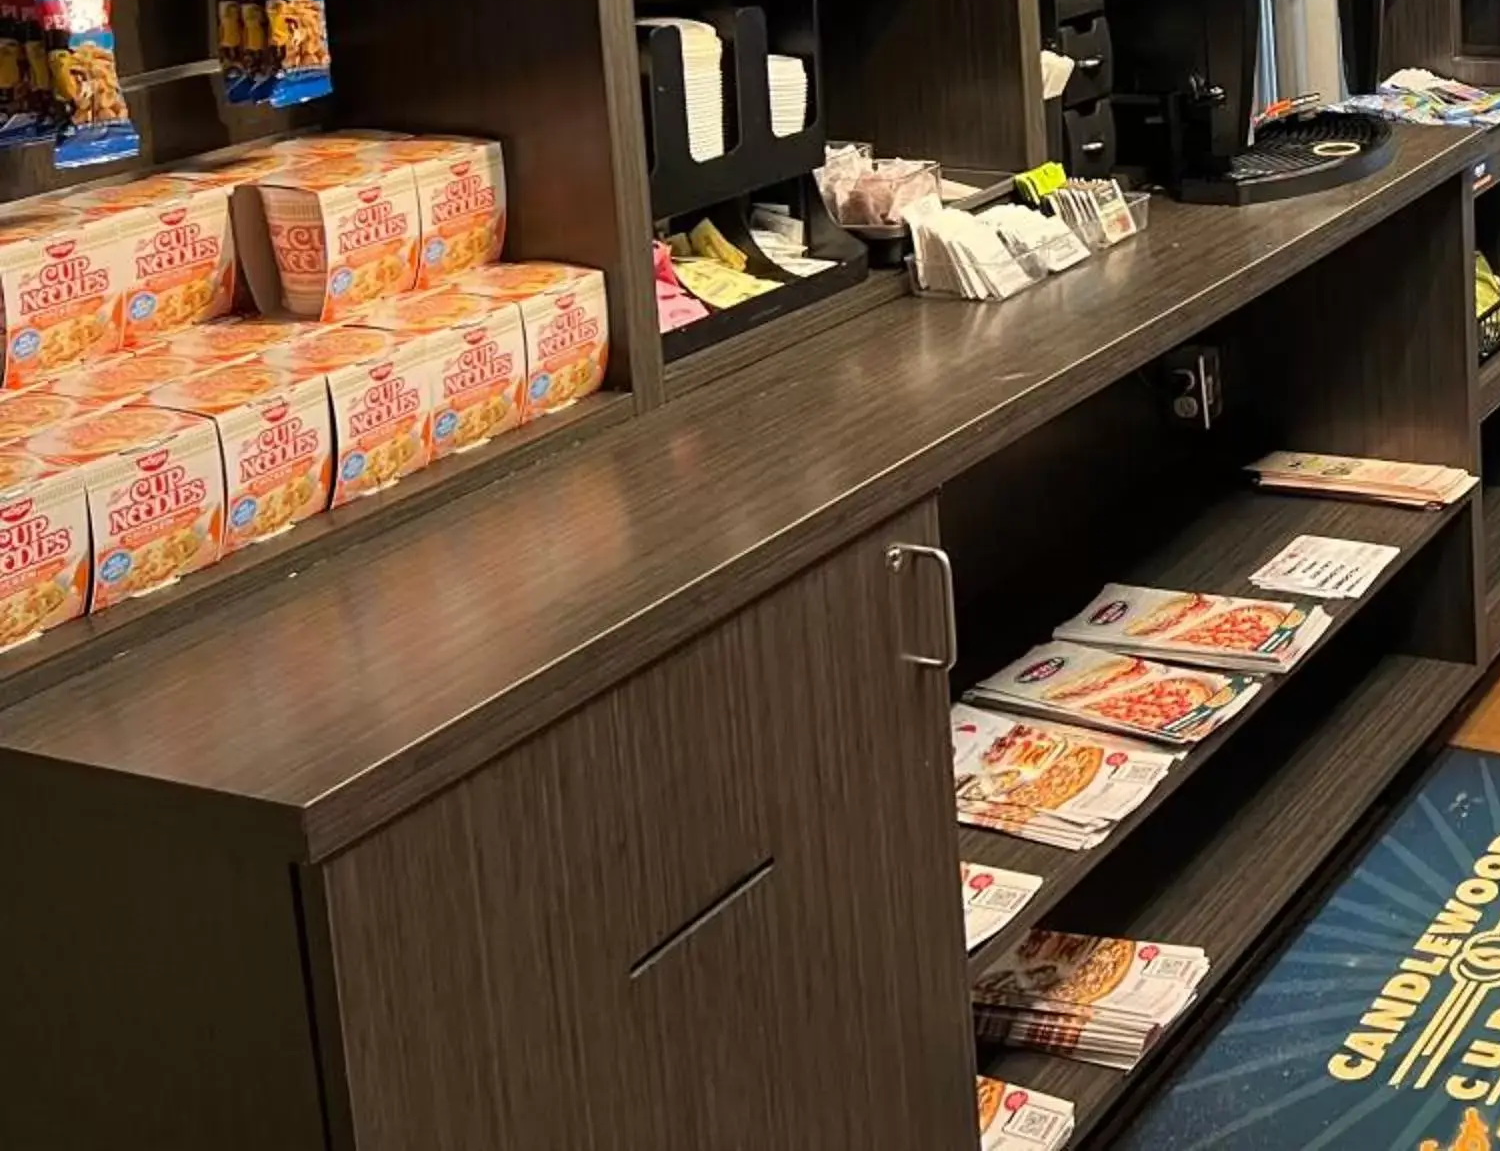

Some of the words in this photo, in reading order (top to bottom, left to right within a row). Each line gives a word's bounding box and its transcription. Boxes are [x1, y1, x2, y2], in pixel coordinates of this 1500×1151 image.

[432, 185, 495, 225] NOODLES
[445, 174, 482, 202] CUP
[338, 213, 408, 254] NOODLES
[354, 201, 393, 230] CUP
[154, 223, 200, 251] CUP
[40, 256, 90, 287] CUP
[136, 236, 219, 279] NOODLES
[19, 269, 110, 315] NOODLES
[443, 352, 514, 400] NOODLES
[457, 340, 498, 374] CUP
[364, 376, 406, 409] CUP
[349, 388, 421, 440] NOODLES
[258, 416, 303, 451] CUP
[239, 428, 319, 484] NOODLES
[129, 465, 186, 501] CUP
[108, 478, 207, 537] NOODLES
